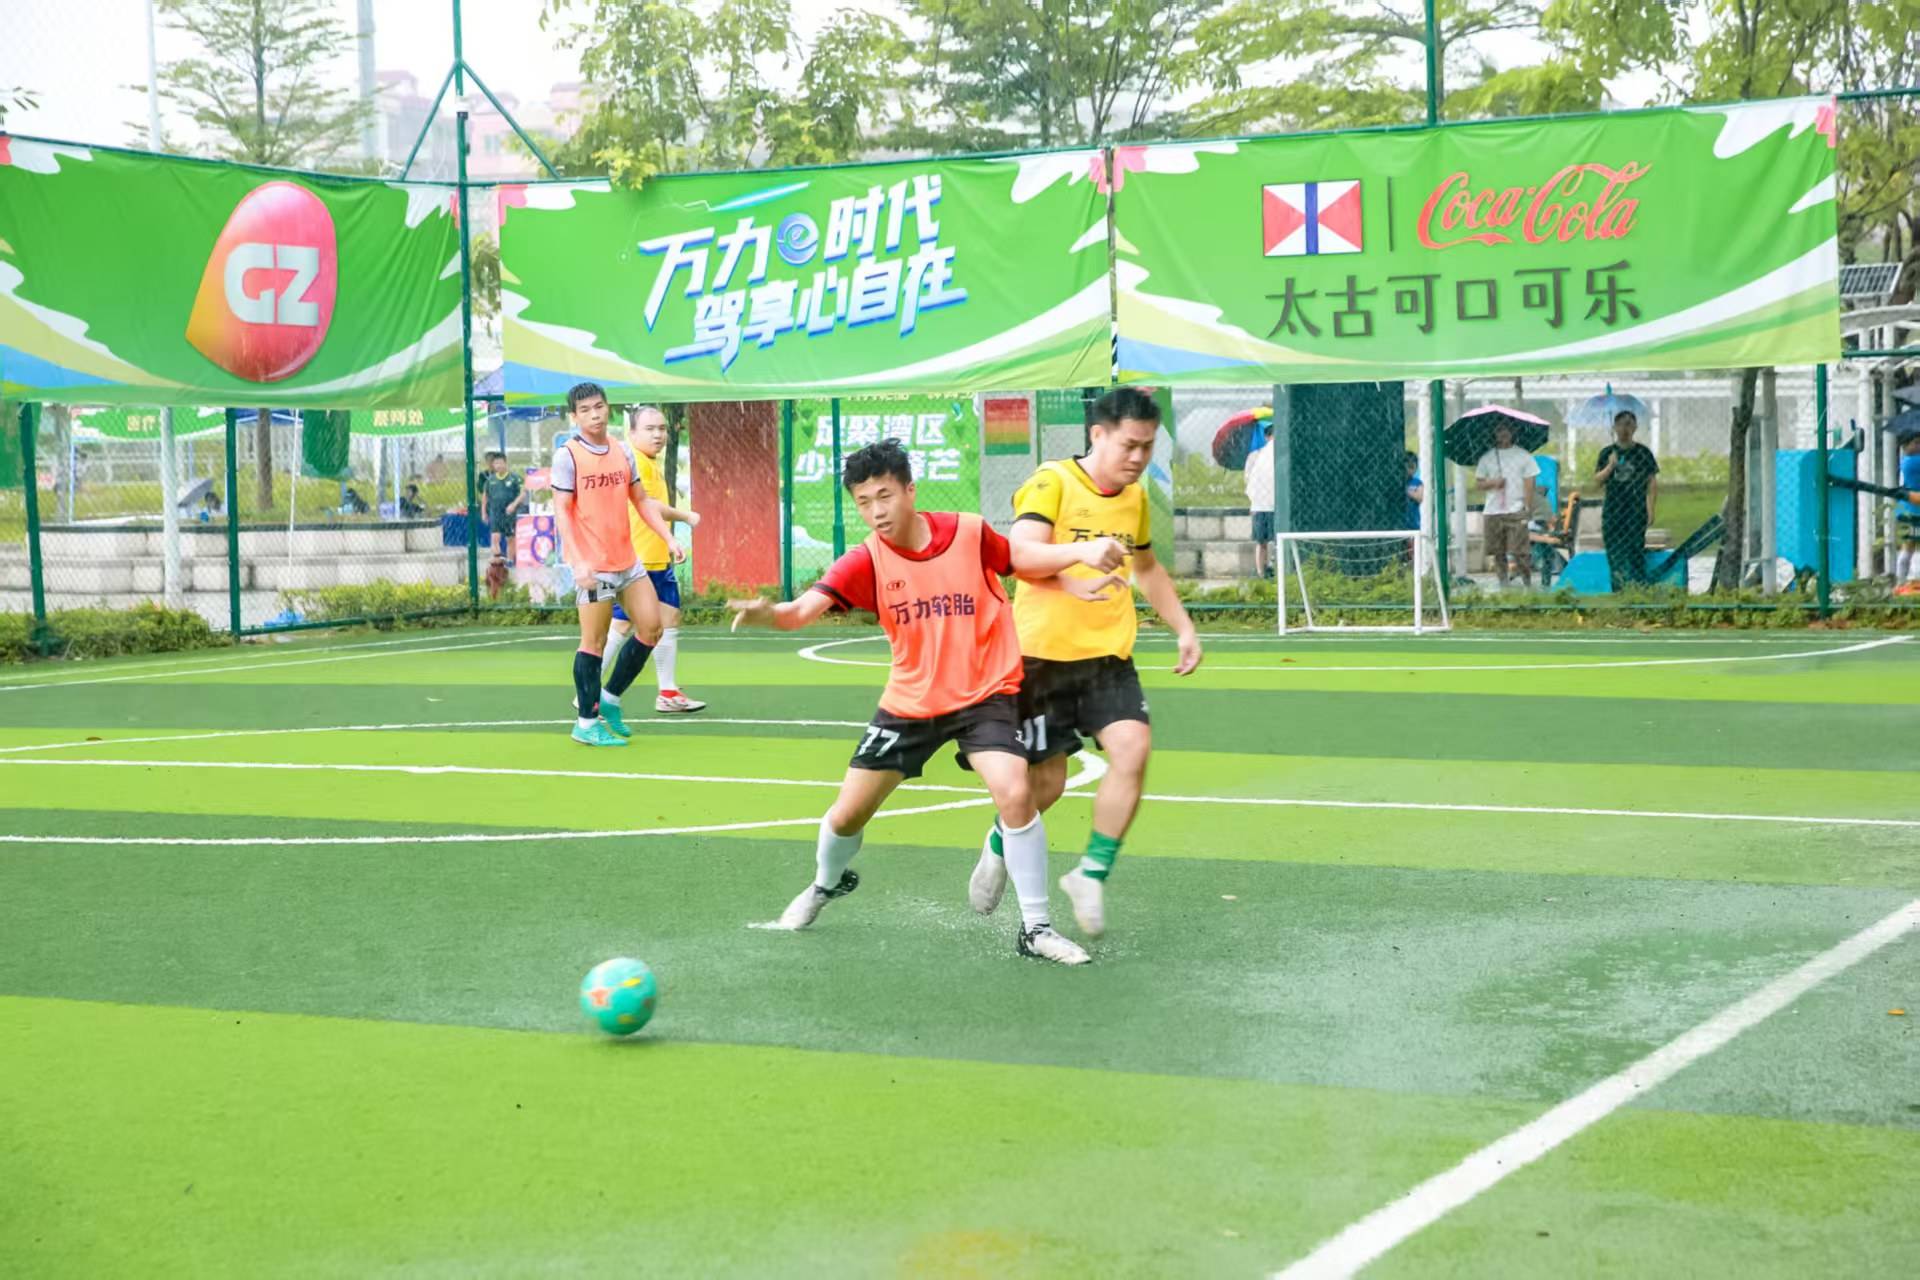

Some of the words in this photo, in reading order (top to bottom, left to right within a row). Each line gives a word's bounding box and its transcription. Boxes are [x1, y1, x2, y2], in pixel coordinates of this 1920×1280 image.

[224, 242, 320, 327] GZ
[664, 245, 968, 375] 驾享心自在
[1265, 260, 1641, 339] 太古可口可乐
[888, 593, 975, 625] 万力轮胎
[856, 725, 900, 758] 77
